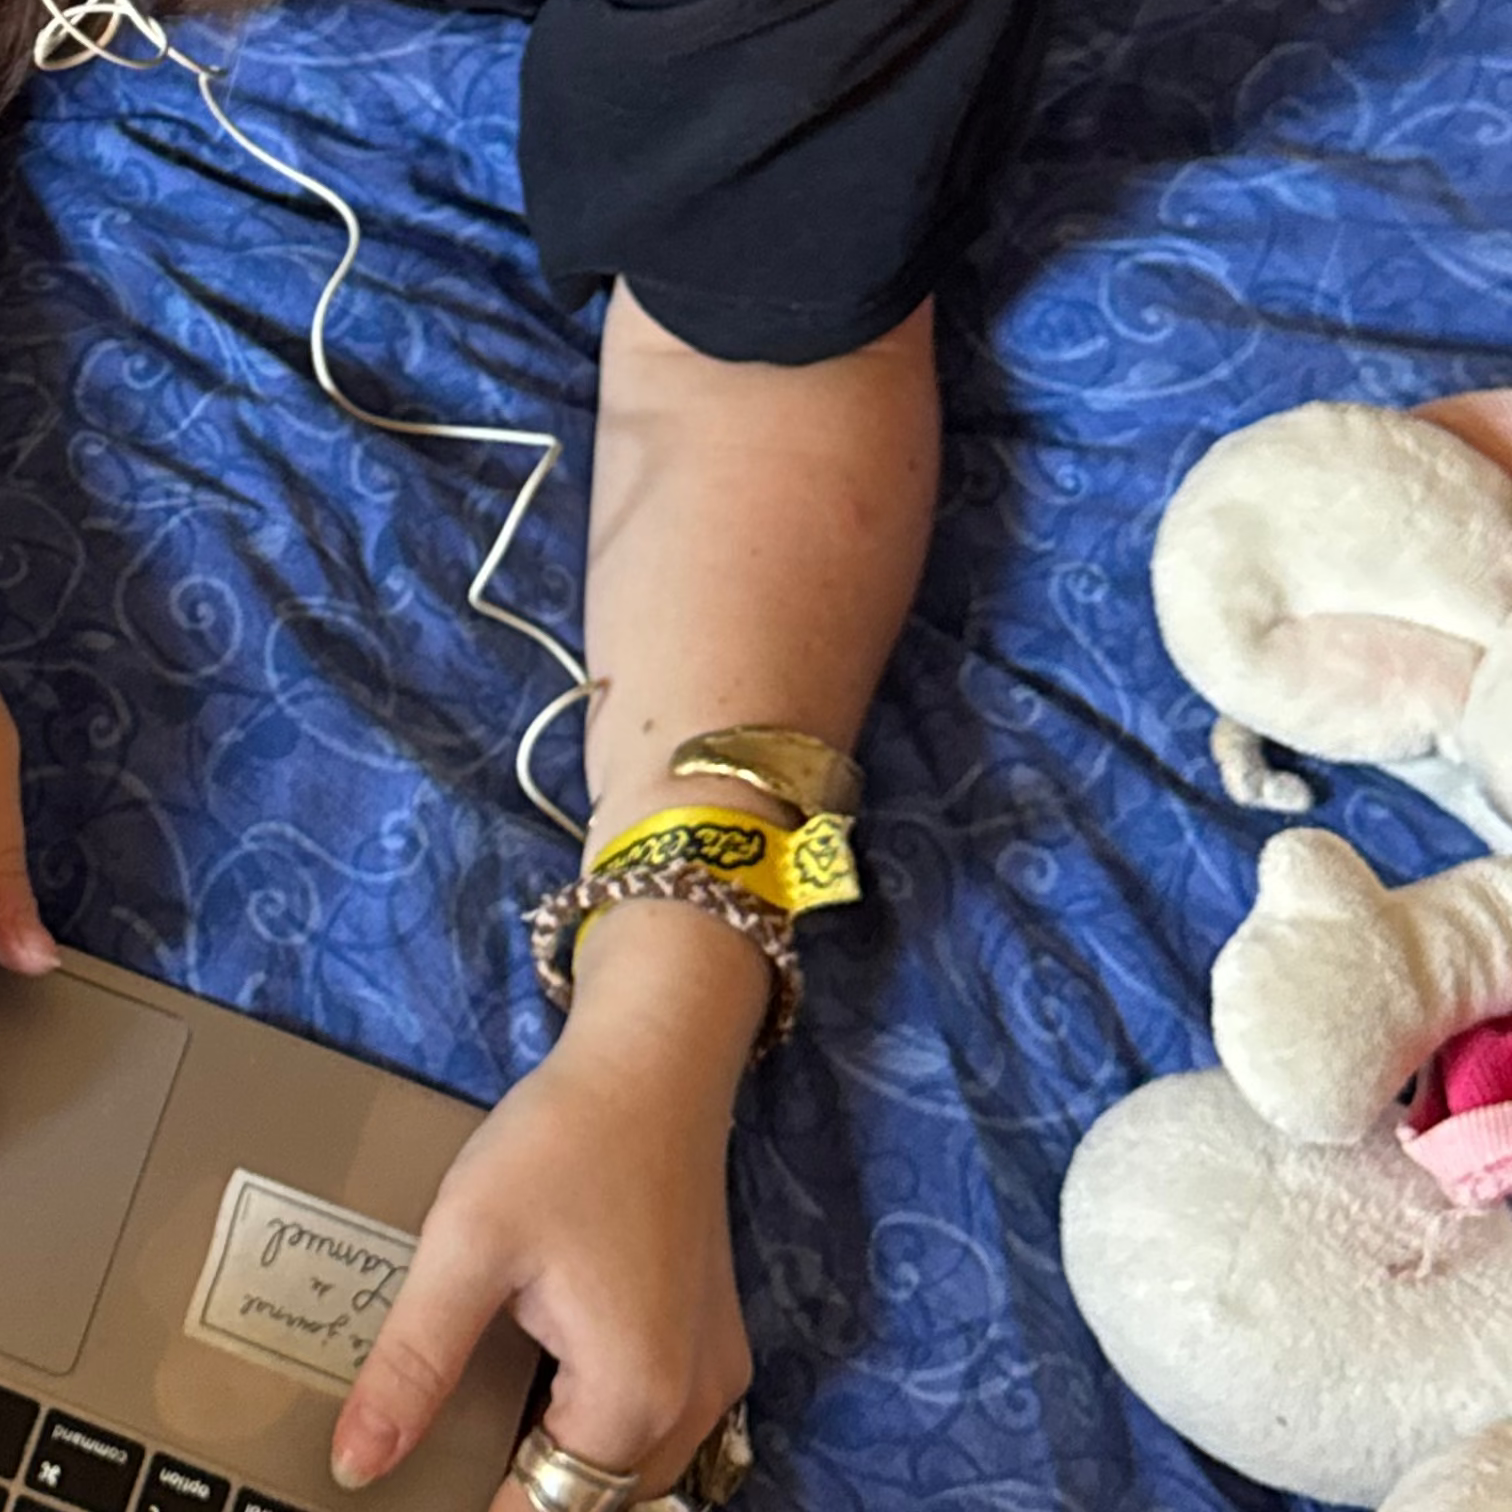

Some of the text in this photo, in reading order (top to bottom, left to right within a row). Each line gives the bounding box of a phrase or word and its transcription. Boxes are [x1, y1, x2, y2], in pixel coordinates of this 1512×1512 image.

[239, 1293, 351, 1346] journal
[51, 1423, 130, 1465] command
[158, 1464, 212, 1499] option
